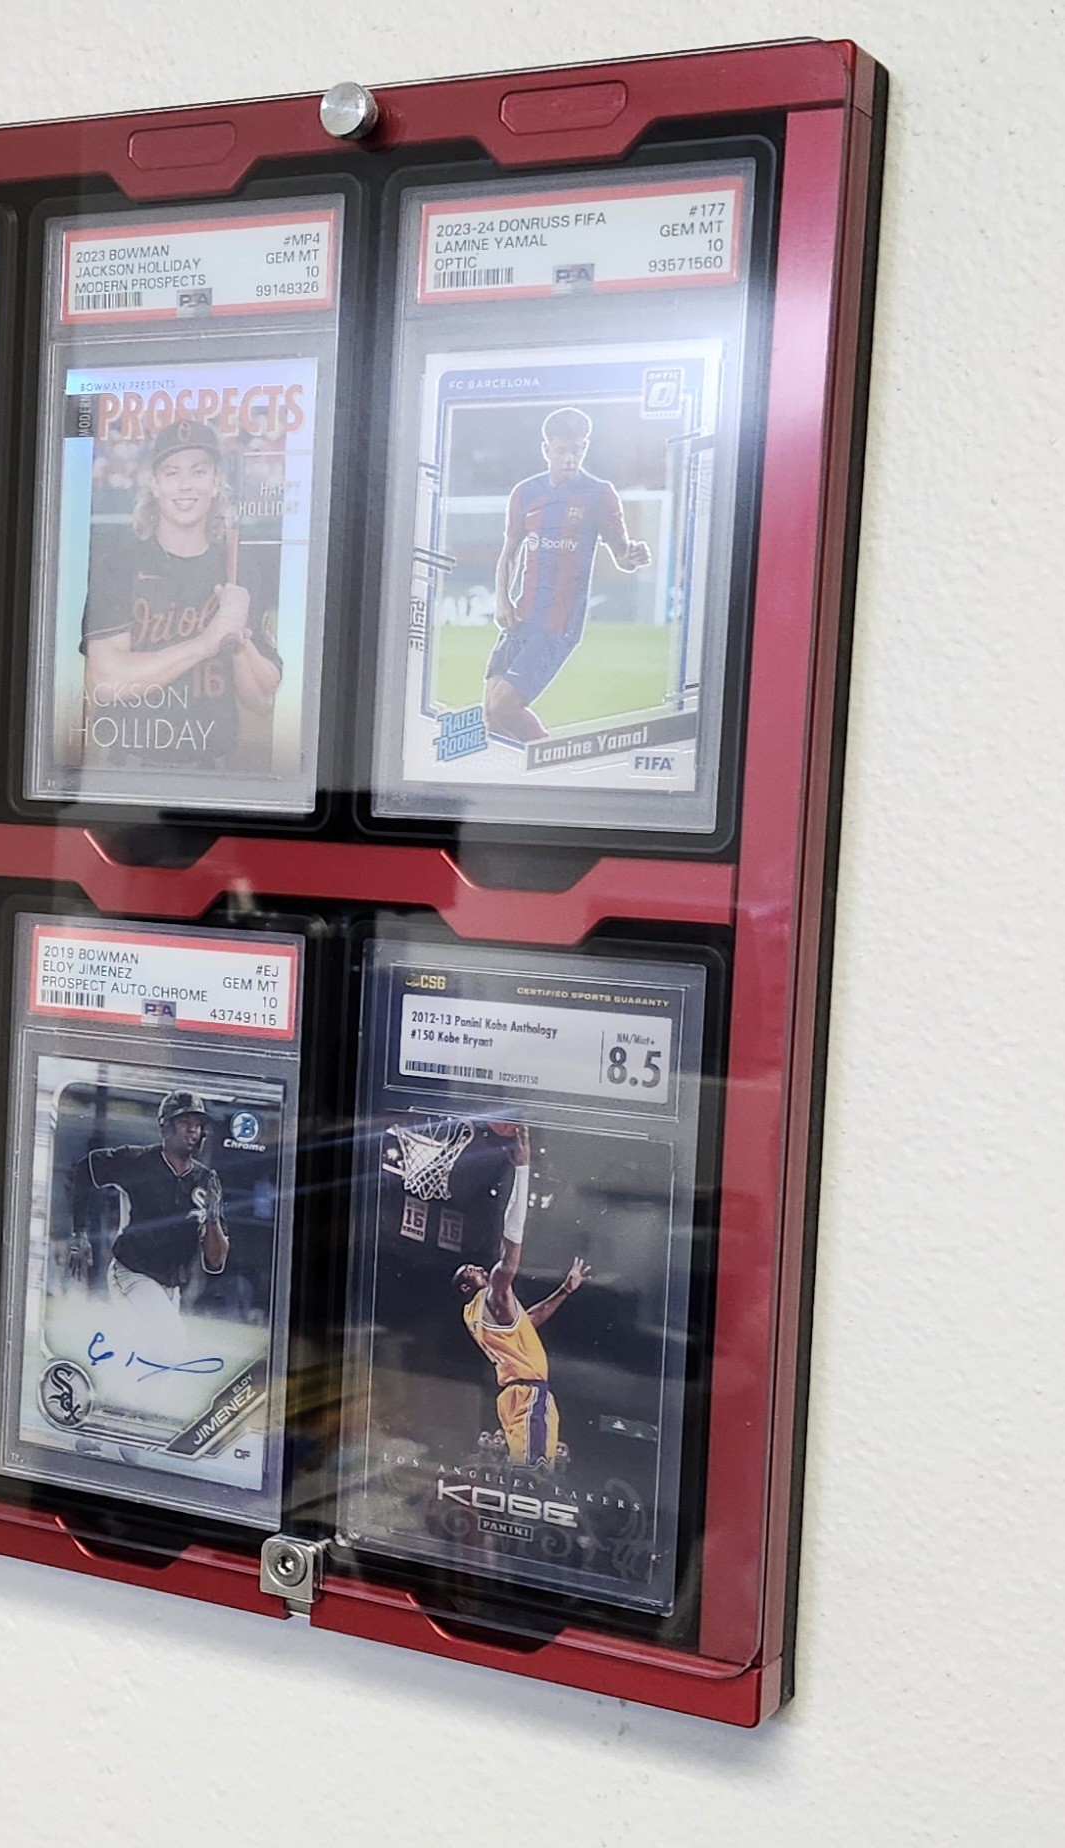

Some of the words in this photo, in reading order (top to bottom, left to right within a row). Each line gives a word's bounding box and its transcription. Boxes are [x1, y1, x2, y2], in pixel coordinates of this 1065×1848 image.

[689, 203, 726, 218] #177
[436, 222, 494, 238] 2023-24
[499, 216, 570, 234] DONRUSS
[574, 212, 607, 226] FIFA
[660, 222, 694, 238] GEM
[699, 220, 723, 234] MT
[284, 233, 320, 247] #MP4
[436, 238, 489, 254] LAMINE
[494, 234, 547, 250] YAMAL
[708, 239, 723, 252] 10
[76, 251, 106, 264] 2023
[109, 246, 170, 261] BOWMAN
[266, 251, 294, 265] GEM
[298, 249, 320, 262] MT
[434, 256, 477, 271] OPTIC
[76, 263, 134, 280] JACKSON
[138, 258, 201, 274] HOLLIDAY
[306, 266, 319, 279] 10
[648, 256, 723, 273] 93571560
[75, 279, 128, 294] MODERN
[132, 274, 206, 290] PROSPECTS
[256, 281, 319, 297] 99148326
[449, 381, 464, 390] FC
[468, 377, 540, 390] BARCELONA
[647, 370, 680, 380] OPTIC
[80, 382, 126, 392] BOWMAN
[129, 380, 176, 391] PRESENTS
[79, 394, 92, 438] MODERN
[98, 384, 304, 441] PROSPECTS
[239, 502, 300, 517] HOLLIDAY
[541, 536, 578, 551] Spotify
[82, 682, 188, 710] ACKSON
[438, 706, 483, 737] RATED
[69, 717, 215, 750] HOLLIDAY
[434, 726, 487, 762] ROOKIE
[535, 738, 594, 764] Lamine
[596, 726, 648, 750] Yamal
[634, 756, 672, 772] FIFA
[44, 946, 74, 959] 2019
[78, 948, 139, 964] BOWMAN
[42, 960, 74, 974] ELOY
[78, 964, 132, 980] JIMENEZ
[256, 964, 280, 978] #EJ
[42, 976, 106, 992] PROSPECT
[222, 976, 252, 990] GEM
[258, 980, 278, 992] MT
[420, 974, 446, 990] CSG
[262, 996, 278, 1008] 10
[516, 986, 568, 1000] CERTIFIED
[571, 992, 612, 1003] SPORTS
[614, 995, 670, 1008] GUARANTY
[210, 1008, 277, 1026] 43749115
[412, 1012, 452, 1027] 2012-13
[454, 1015, 482, 1030] Panini
[485, 1018, 508, 1032] Kobe
[510, 1020, 558, 1040] Anthology
[410, 1029, 434, 1042] #150
[438, 1032, 460, 1044] Kobe
[462, 1034, 494, 1050] Bryant
[616, 1032, 656, 1047] NM/Mint+
[607, 1046, 662, 1089] 8.5
[223, 1138, 266, 1152] Chrome
[232, 1374, 253, 1394] ELOY
[193, 1386, 256, 1446] JIMENEZ
[234, 1449, 250, 1459] OF
[384, 1452, 419, 1468] LOS
[438, 1464, 534, 1490] ANGELES
[555, 1486, 640, 1512] LAKERS
[437, 1479, 579, 1528] KOBE
[482, 1520, 529, 1538] PANINI
